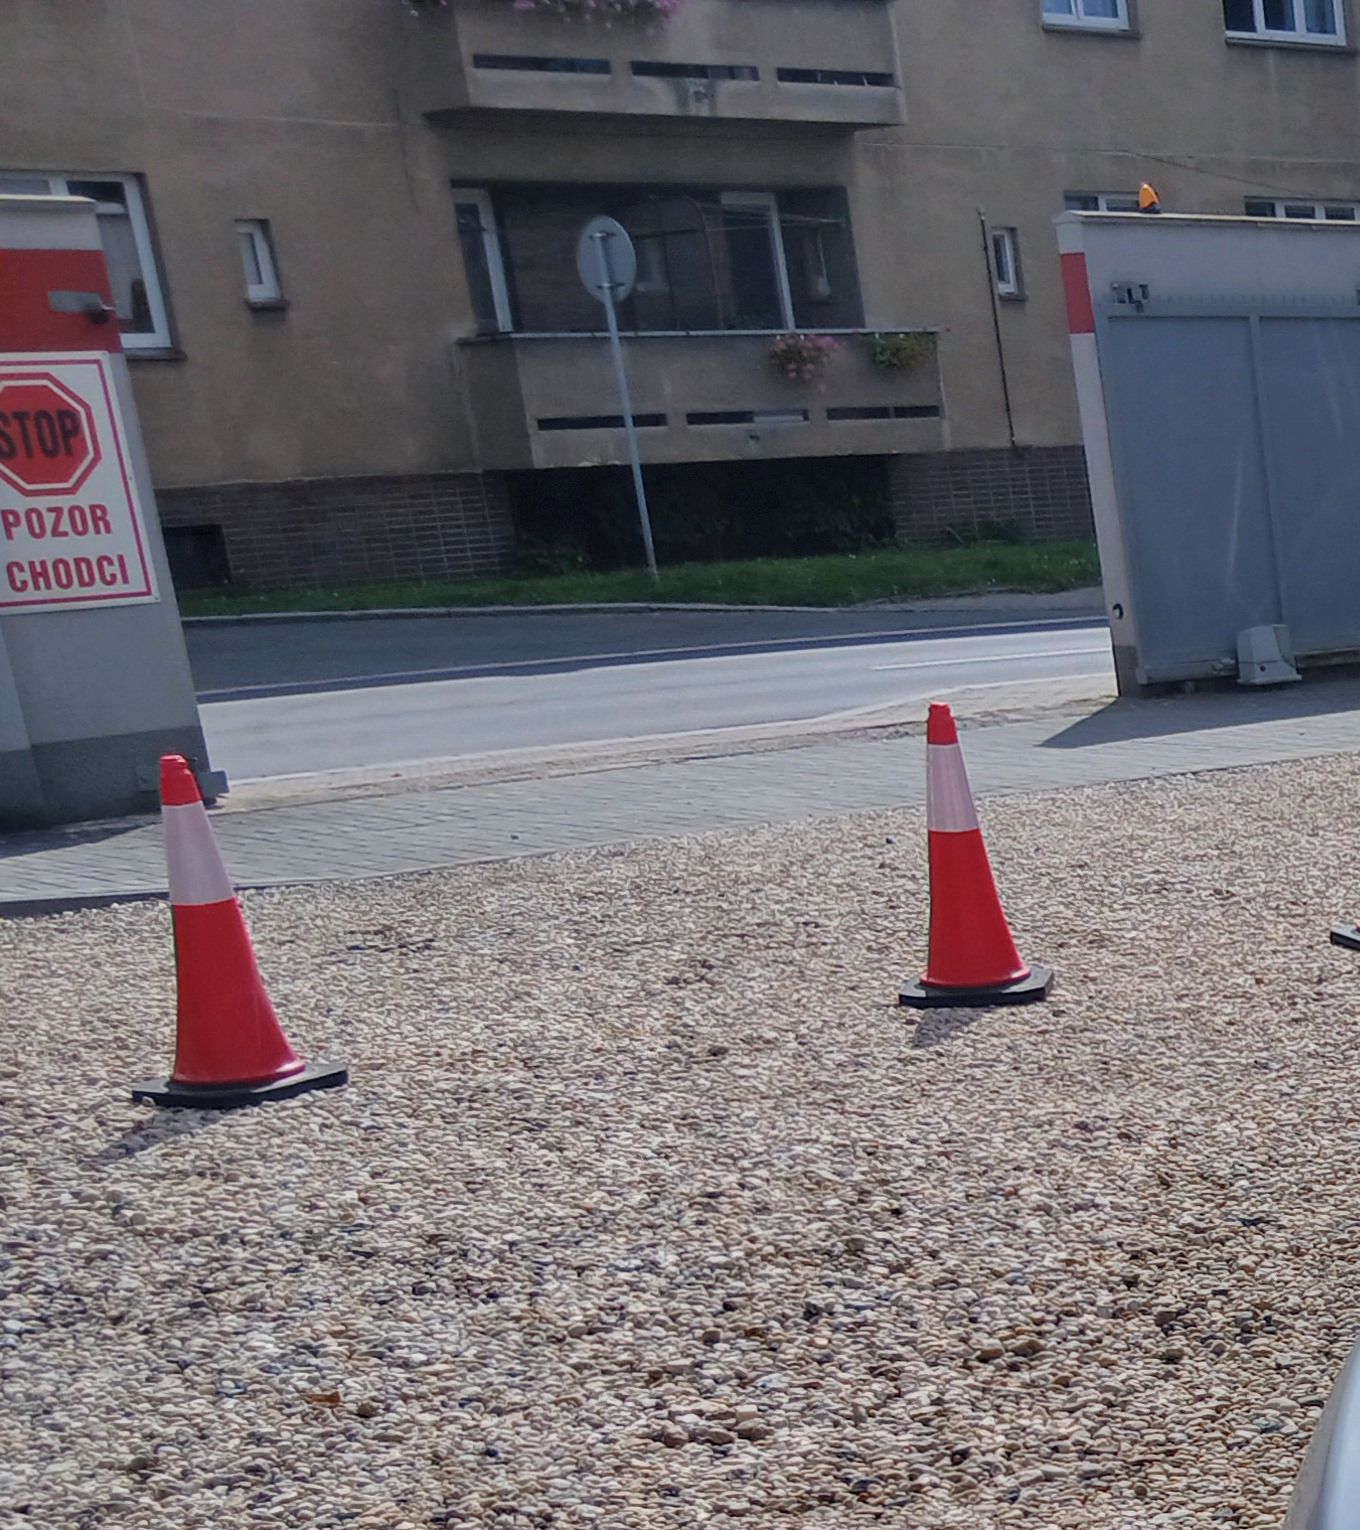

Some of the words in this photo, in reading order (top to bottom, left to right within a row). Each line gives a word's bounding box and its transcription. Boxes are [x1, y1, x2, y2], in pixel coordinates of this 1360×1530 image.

[0, 409, 81, 461] STOP
[1, 504, 112, 541] POZOR
[6, 554, 130, 593] CHODCI
